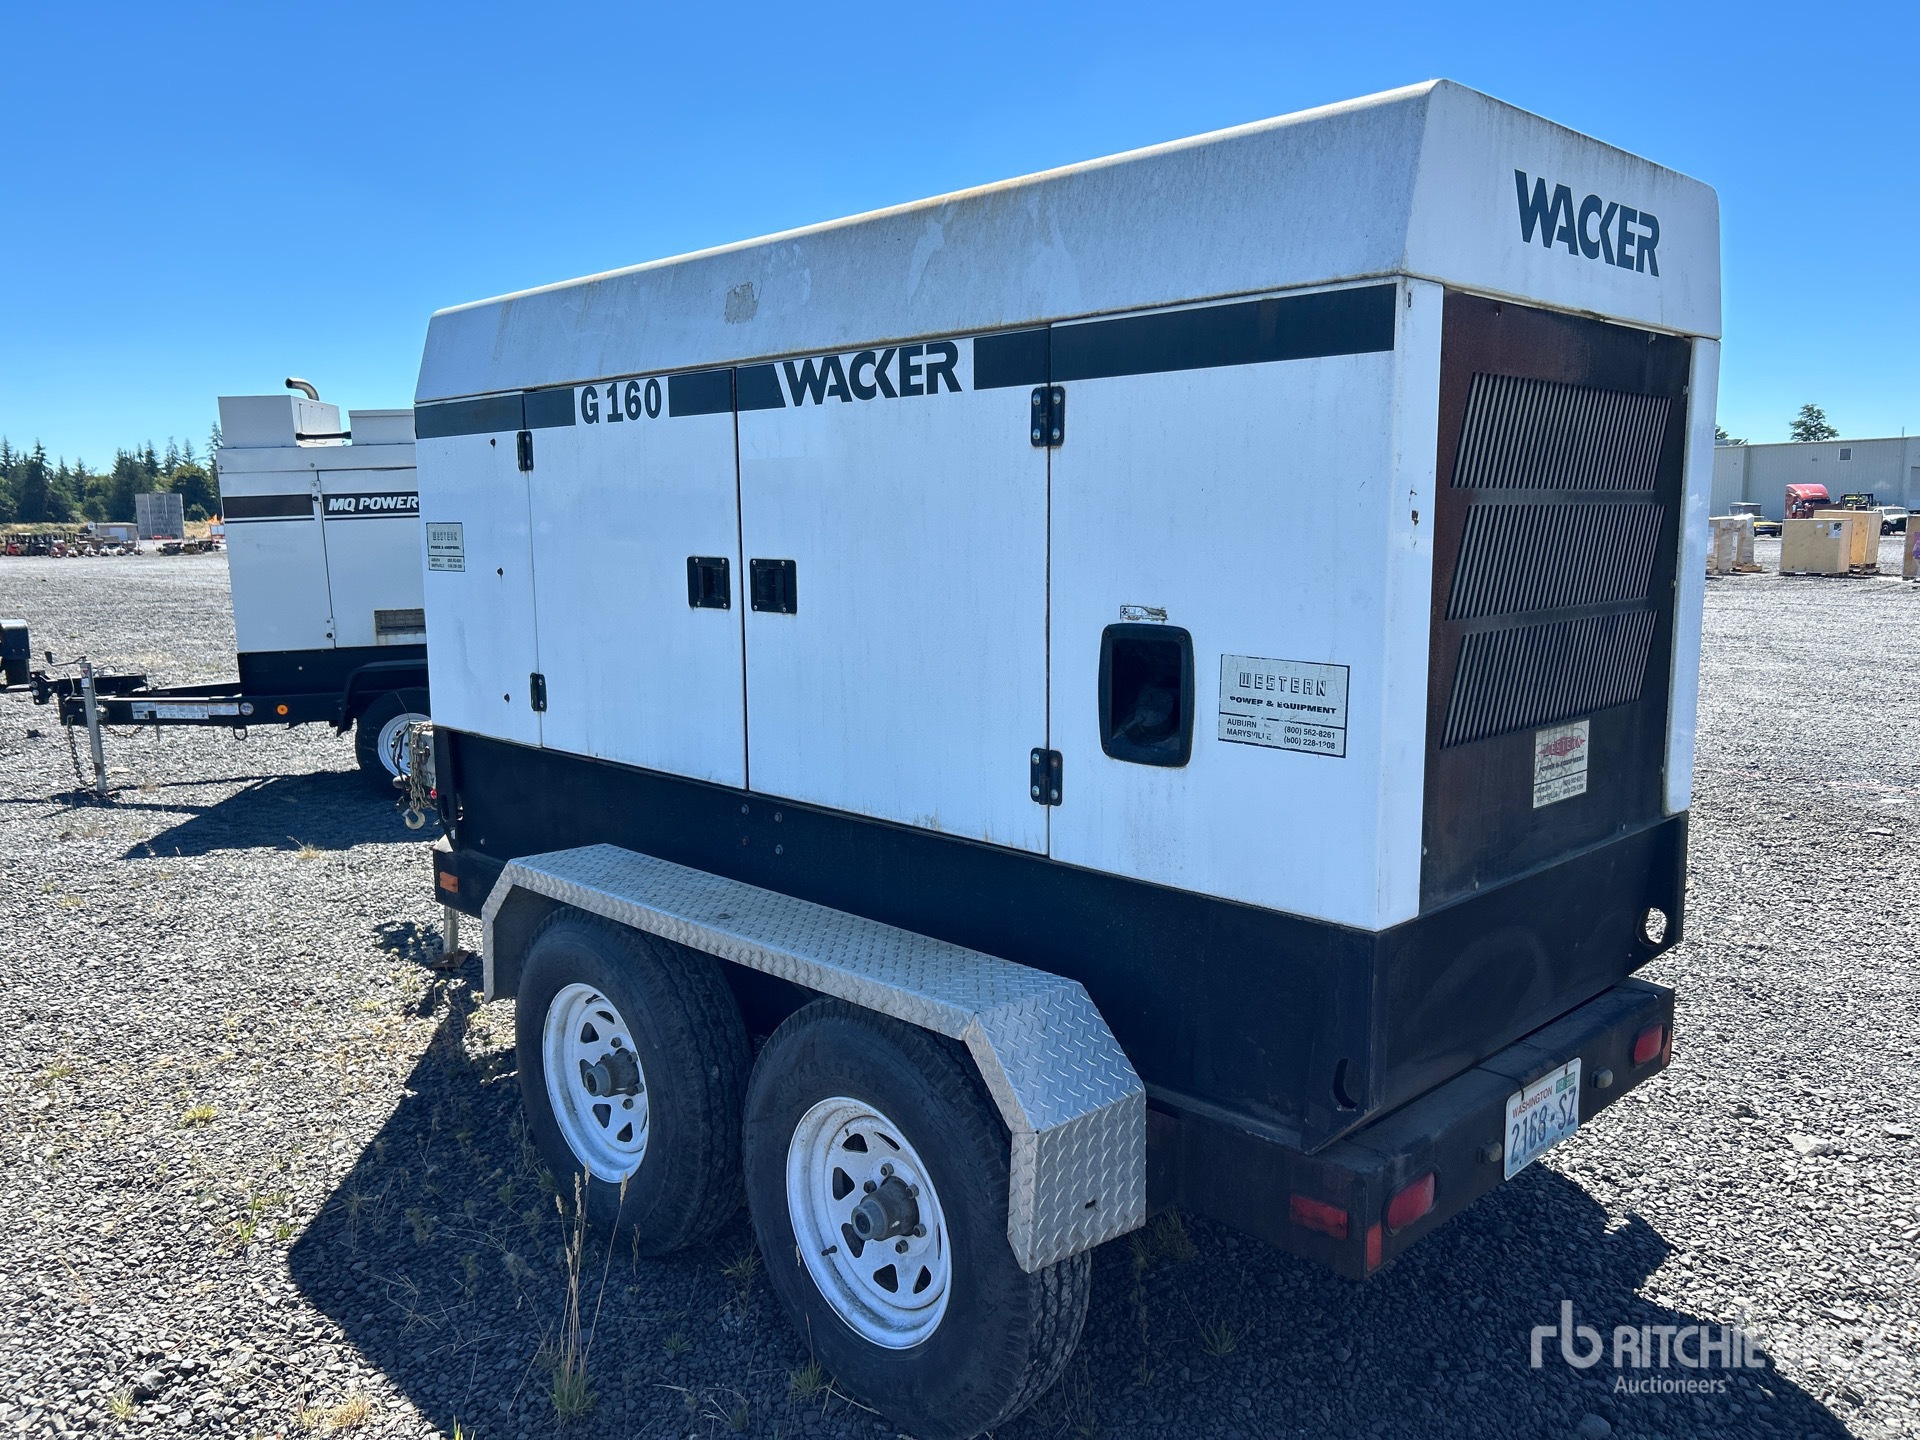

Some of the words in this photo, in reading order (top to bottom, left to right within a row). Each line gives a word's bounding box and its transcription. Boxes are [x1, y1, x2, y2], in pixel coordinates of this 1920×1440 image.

[1514, 168, 1660, 278] WACKER
[782, 341, 963, 407] WACKER
[580, 385, 600, 425] G
[606, 378, 662, 423] 160
[328, 497, 356, 512] MQ
[358, 495, 419, 510] POWER
[1239, 671, 1327, 696] WESTERN
[1276, 701, 1337, 715] EQUIPMENT
[1226, 718, 1257, 729] AUBURN
[1284, 725, 1302, 739] (800)
[1512, 1086, 1553, 1119] WASHINGTON
